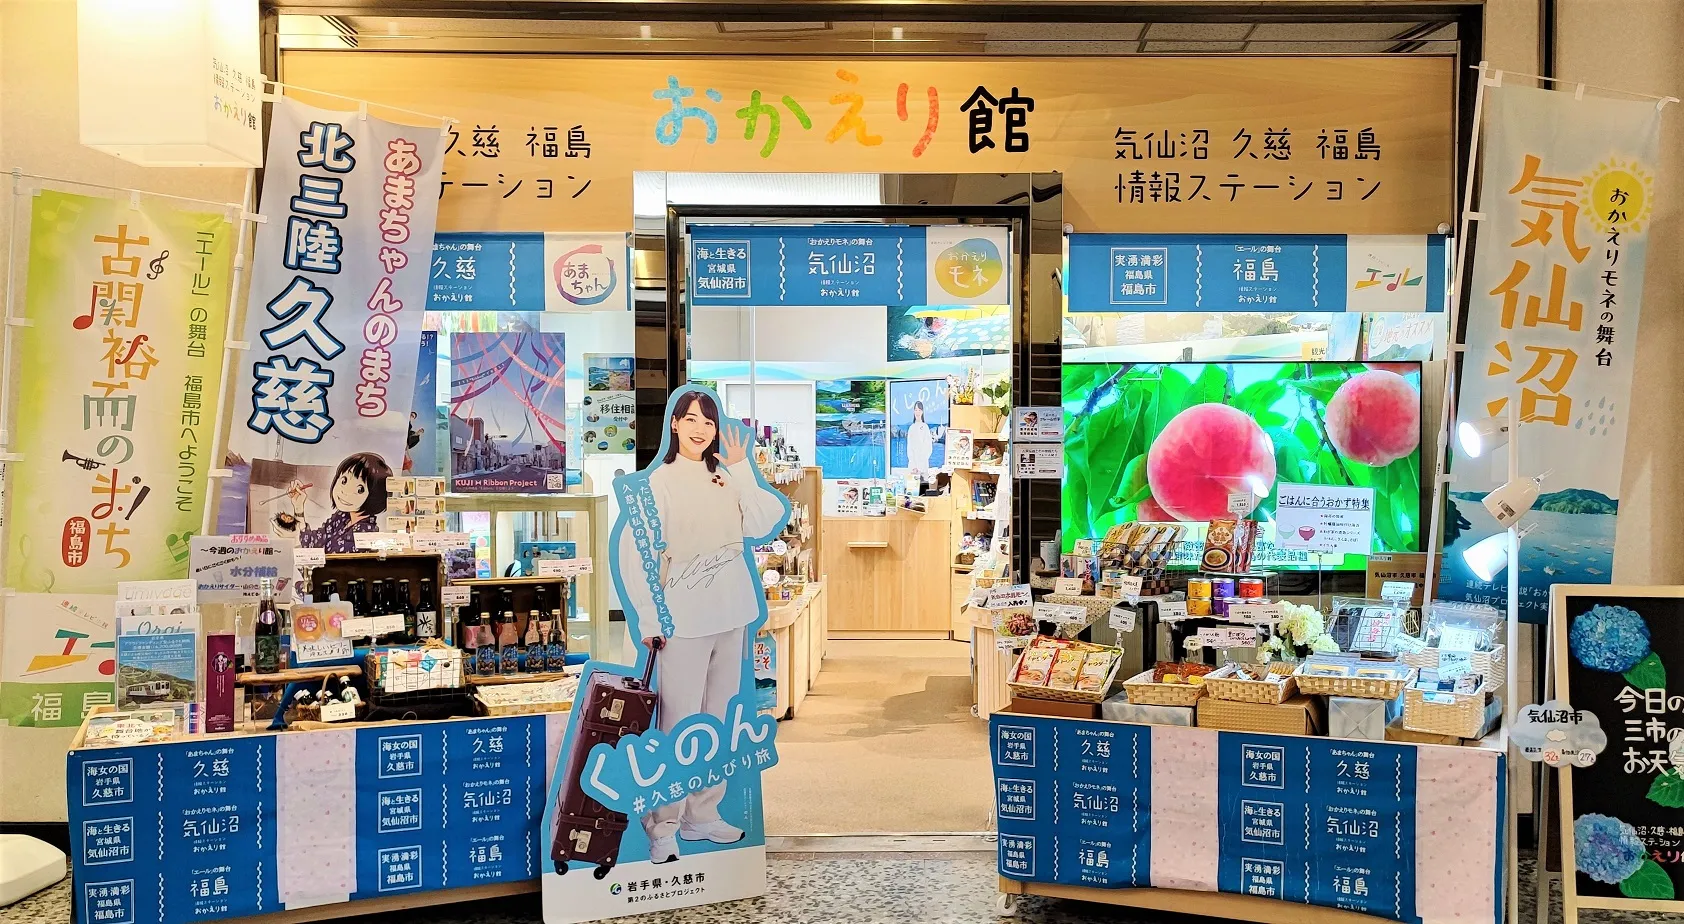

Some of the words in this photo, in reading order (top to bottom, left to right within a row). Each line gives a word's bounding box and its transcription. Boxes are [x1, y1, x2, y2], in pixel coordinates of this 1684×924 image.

[652, 68, 1035, 158] おかえり館
[526, 124, 592, 158] 福島
[1114, 127, 1210, 161] 気仙沼
[1232, 127, 1293, 161] 久慈
[1315, 127, 1382, 161] 福島
[1114, 169, 1382, 204] 情報ステーション
[696, 247, 747, 260] 海と生きる
[948, 251, 987, 262] おかえり
[1234, 245, 1282, 253] 「エール」の舞台
[432, 256, 476, 280] 久慈
[564, 262, 590, 279] あま
[707, 264, 736, 274] 宮城県
[808, 251, 875, 275] 気仙沼
[1232, 258, 1279, 282] 福島
[247, 120, 356, 444] 北三陸久慈
[355, 137, 422, 419] あまちゃんのまち
[697, 277, 746, 289] 気仙沼市
[948, 265, 989, 288] モネ
[1124, 270, 1154, 280] 福島県
[1595, 187, 1631, 368] おかえりモネの舞台
[571, 277, 608, 296] ちゃん
[820, 287, 860, 298] おかえり館
[1120, 283, 1157, 295] 福島市
[1486, 153, 1592, 427] 気仙沼
[433, 292, 473, 302] おかえり館
[1238, 294, 1277, 304] おかえり館
[177, 374, 203, 513] 福島市へようこそ
[483, 479, 509, 487] Ribbon
[509, 479, 538, 488] Project
[1279, 495, 1370, 510] ごはんに合うおかず特集
[67, 518, 87, 566] 福島市
[622, 483, 674, 637] 久慈は私の第2のふるさとです
[230, 565, 279, 577] 水分補給
[1466, 579, 1550, 597] 連続テレビ説「おか
[1465, 593, 1549, 611] 気仙沼プロェクト実
[1614, 685, 1684, 714] 今日の
[1527, 709, 1583, 725] 気仙沼市
[1000, 730, 1032, 741] 海女の国
[382, 739, 418, 752] 海女の国
[472, 735, 504, 754] 久慈
[590, 703, 769, 801] くじのん
[1081, 739, 1111, 758] 久慈
[1004, 750, 1029, 761] 久慈市
[1245, 750, 1281, 762] 海女の国
[86, 762, 129, 776] 海女の国
[193, 757, 230, 778] 久慈
[386, 761, 414, 772] 久慈市
[1336, 760, 1370, 780] 久慈
[95, 777, 121, 786] 岩手県
[632, 747, 772, 814] #久慈のんびり旅
[1249, 771, 1277, 782] 久慈市
[92, 786, 124, 799] 久慈市
[1000, 783, 1033, 794] 海と生きる
[381, 794, 419, 807] 海と生きる
[463, 788, 512, 809] 気仙沼
[1072, 792, 1119, 813] 気仙沼
[1000, 803, 1032, 814] 気仙沼市
[1244, 805, 1281, 817] 海と生きる
[183, 815, 239, 837] 気仙沼
[382, 815, 418, 827] 気仙沼市
[1326, 816, 1379, 838] 気仙沼
[86, 823, 131, 837] 海と生きる
[1244, 827, 1281, 839] 気仙沼市
[95, 836, 121, 845] 宮城県
[87, 845, 130, 859] 気仙沼市
[469, 844, 502, 864] 福島
[1078, 849, 1110, 869] 福島
[1005, 859, 1028, 870] 福島市
[190, 876, 229, 897] 福島
[387, 872, 414, 885] 福島市
[627, 872, 706, 892] 岩手県・久慈市
[1333, 876, 1368, 897] 福島
[627, 887, 706, 903] 第2のふるさとプロジェクト
[1248, 885, 1276, 897] 福島市
[97, 898, 122, 907] 福島県
[94, 908, 125, 920] 福島市
